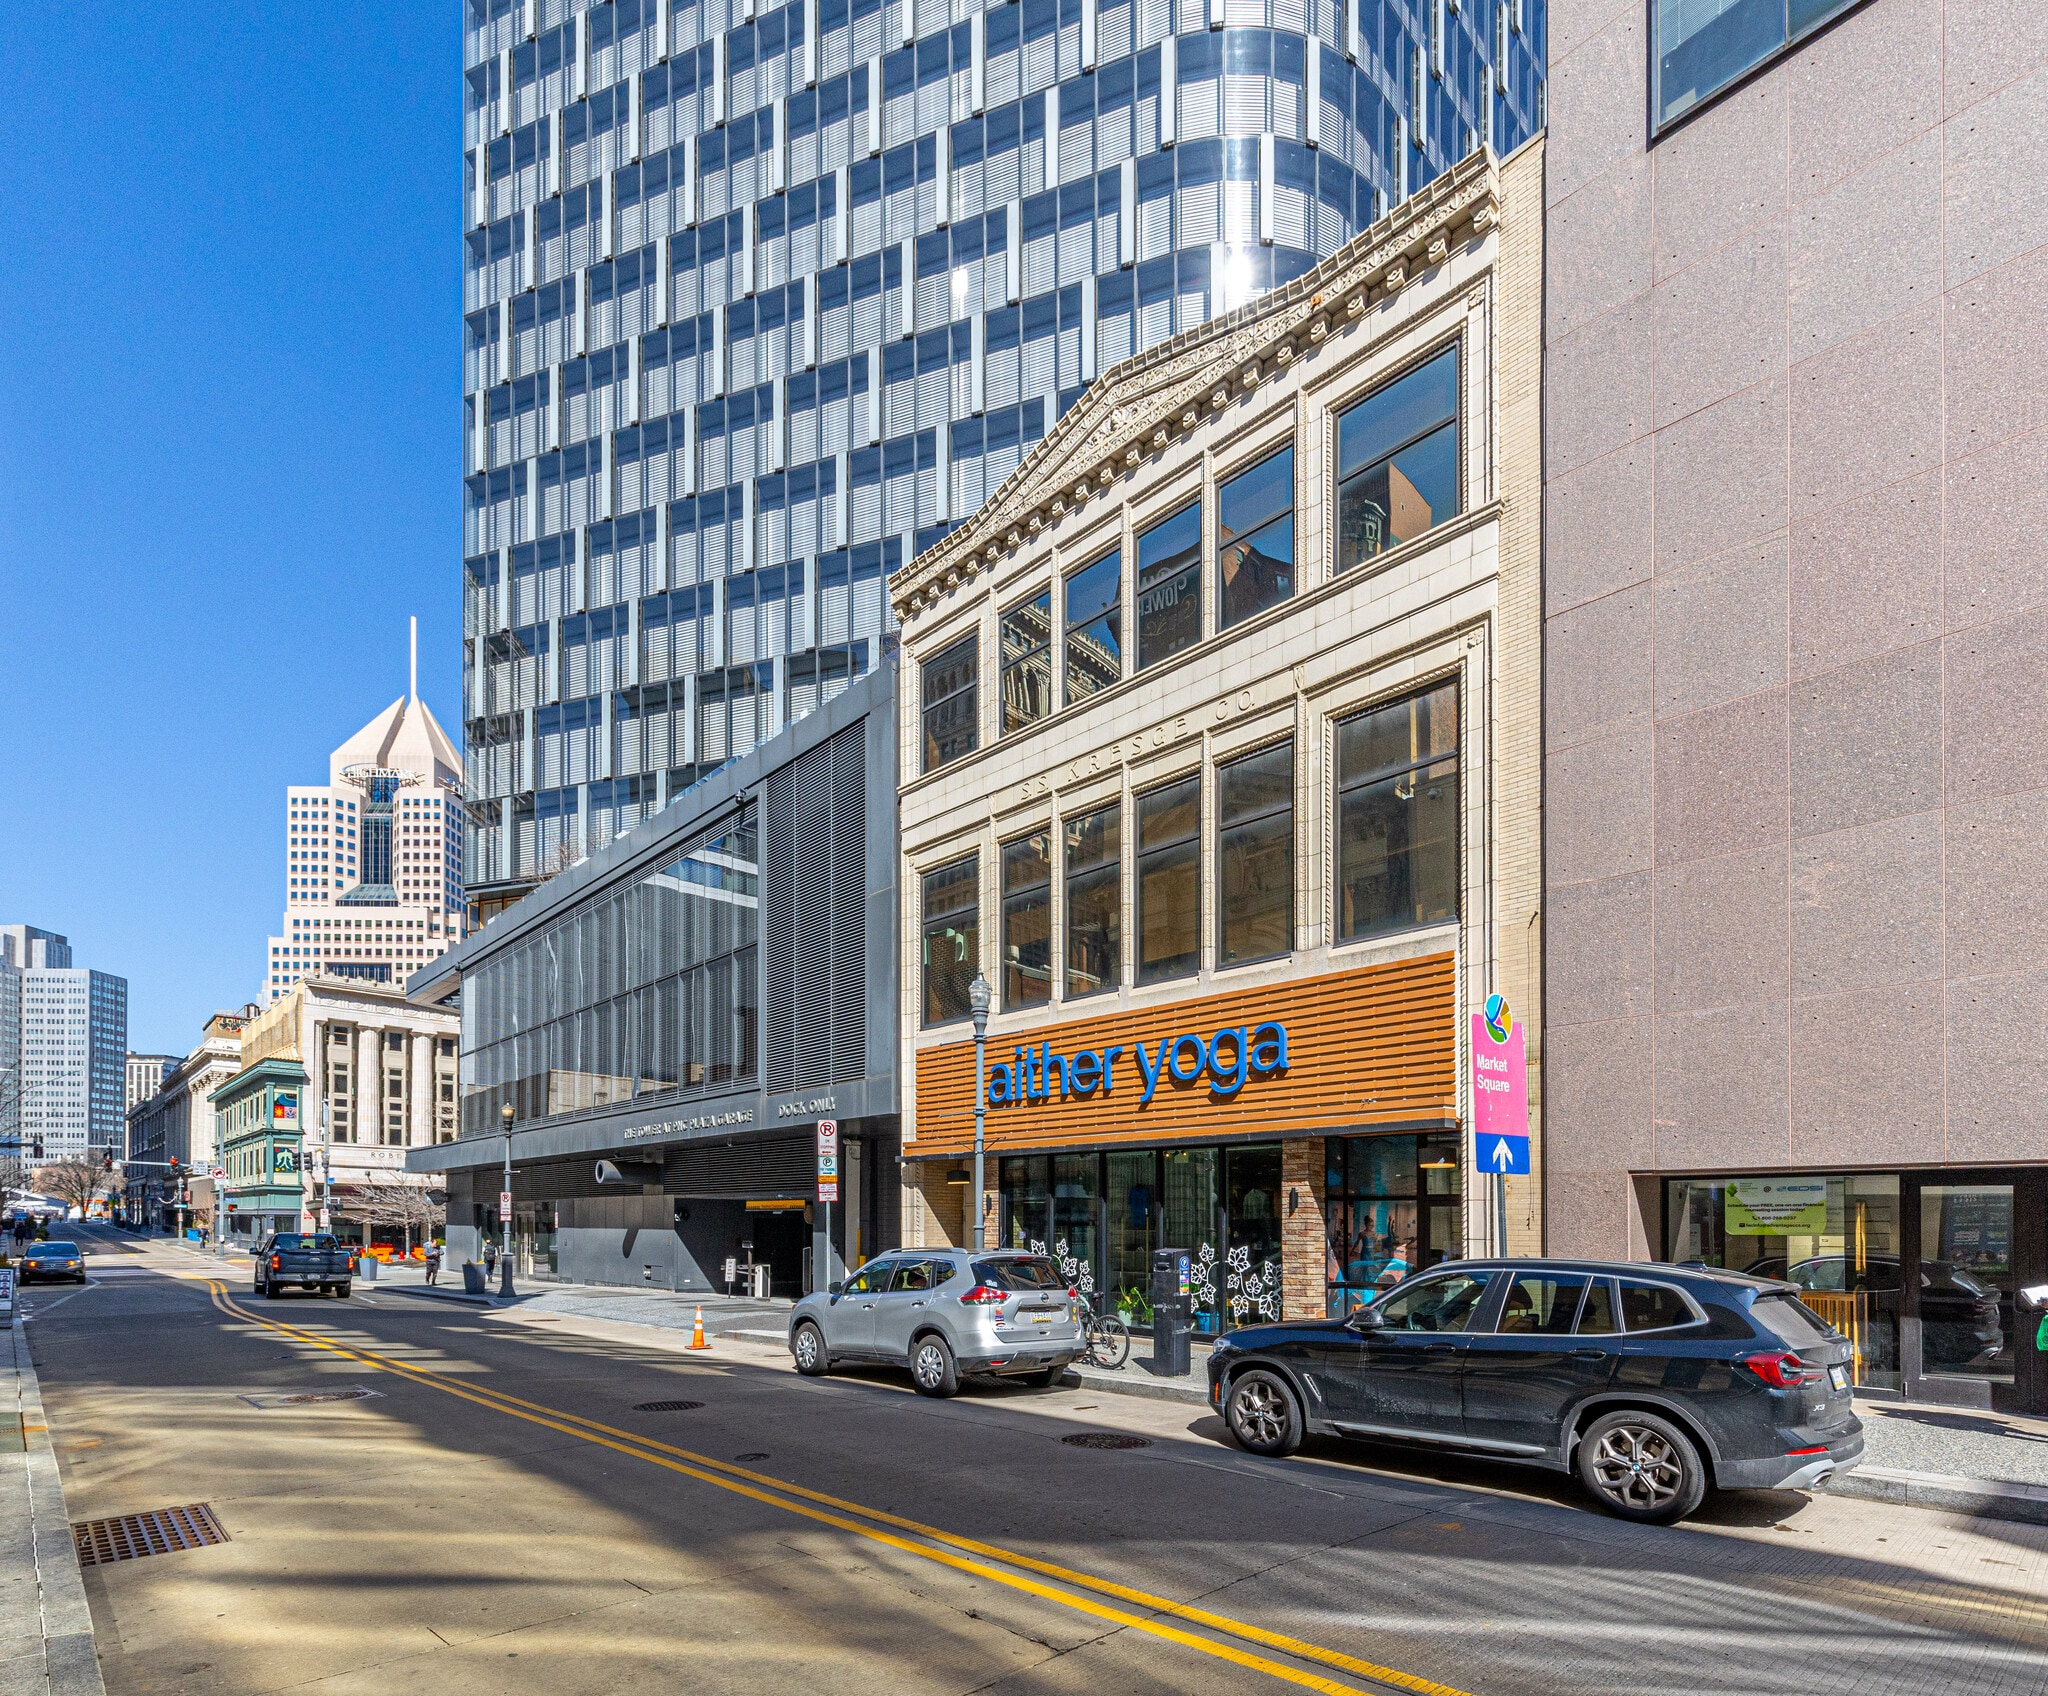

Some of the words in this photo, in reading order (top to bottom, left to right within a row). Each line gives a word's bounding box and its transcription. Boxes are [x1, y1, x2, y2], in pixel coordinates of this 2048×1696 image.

[1067, 718, 1188, 782] KRESGE
[1216, 691, 1255, 721] CO.
[988, 1041, 1123, 1103] aither
[1135, 1021, 1290, 1102] yoga
[1476, 1053, 1508, 1072] Market
[1477, 1074, 1510, 1093] Square
[778, 1101, 807, 1118] DOCK
[809, 1096, 837, 1113] ONLY
[624, 1127, 636, 1139] THE
[637, 1124, 661, 1137] TOWER
[662, 1121, 671, 1134] AT
[673, 1119, 688, 1132] PNC
[689, 1116, 716, 1130] PLAZA
[717, 1109, 753, 1126] GARAGE
